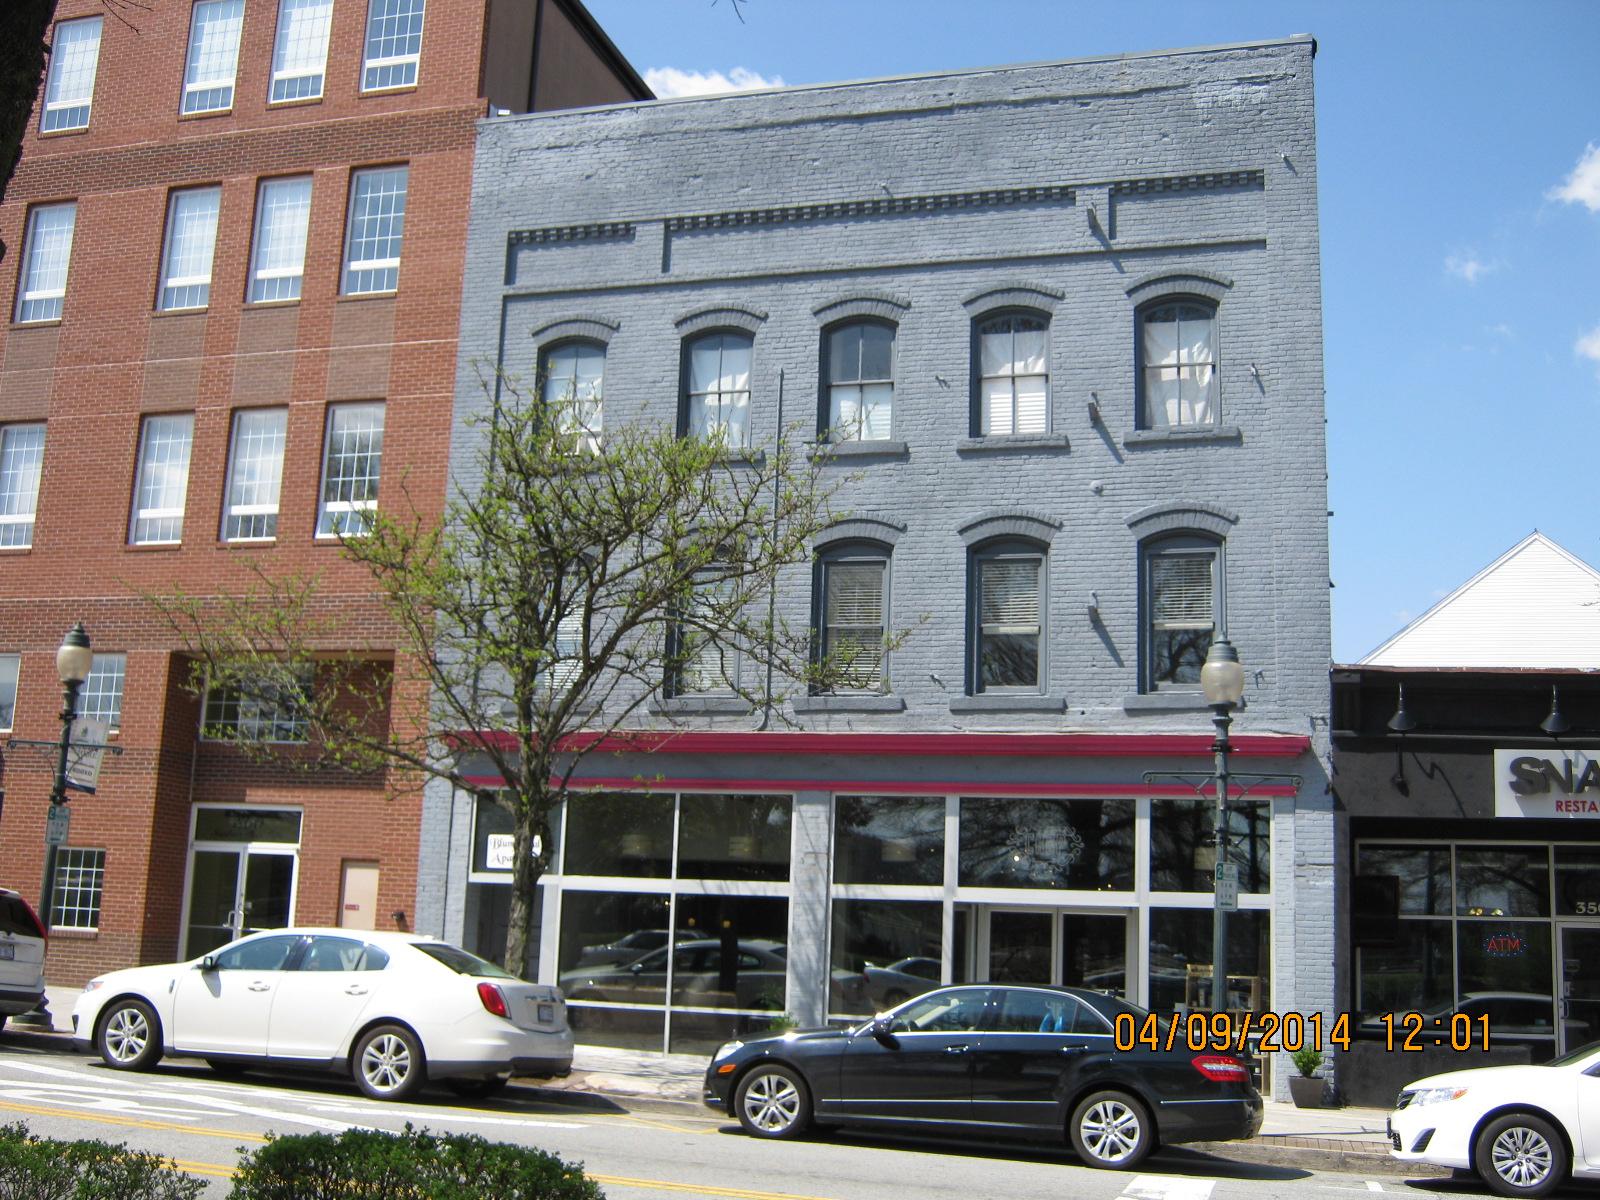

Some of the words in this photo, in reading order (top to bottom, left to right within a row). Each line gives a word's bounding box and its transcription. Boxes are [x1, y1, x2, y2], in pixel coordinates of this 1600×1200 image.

[1508, 756, 1600, 795] SNA
[1555, 800, 1599, 812] RESTA
[1575, 901, 1600, 914] 35
[1487, 937, 1521, 953] ATM
